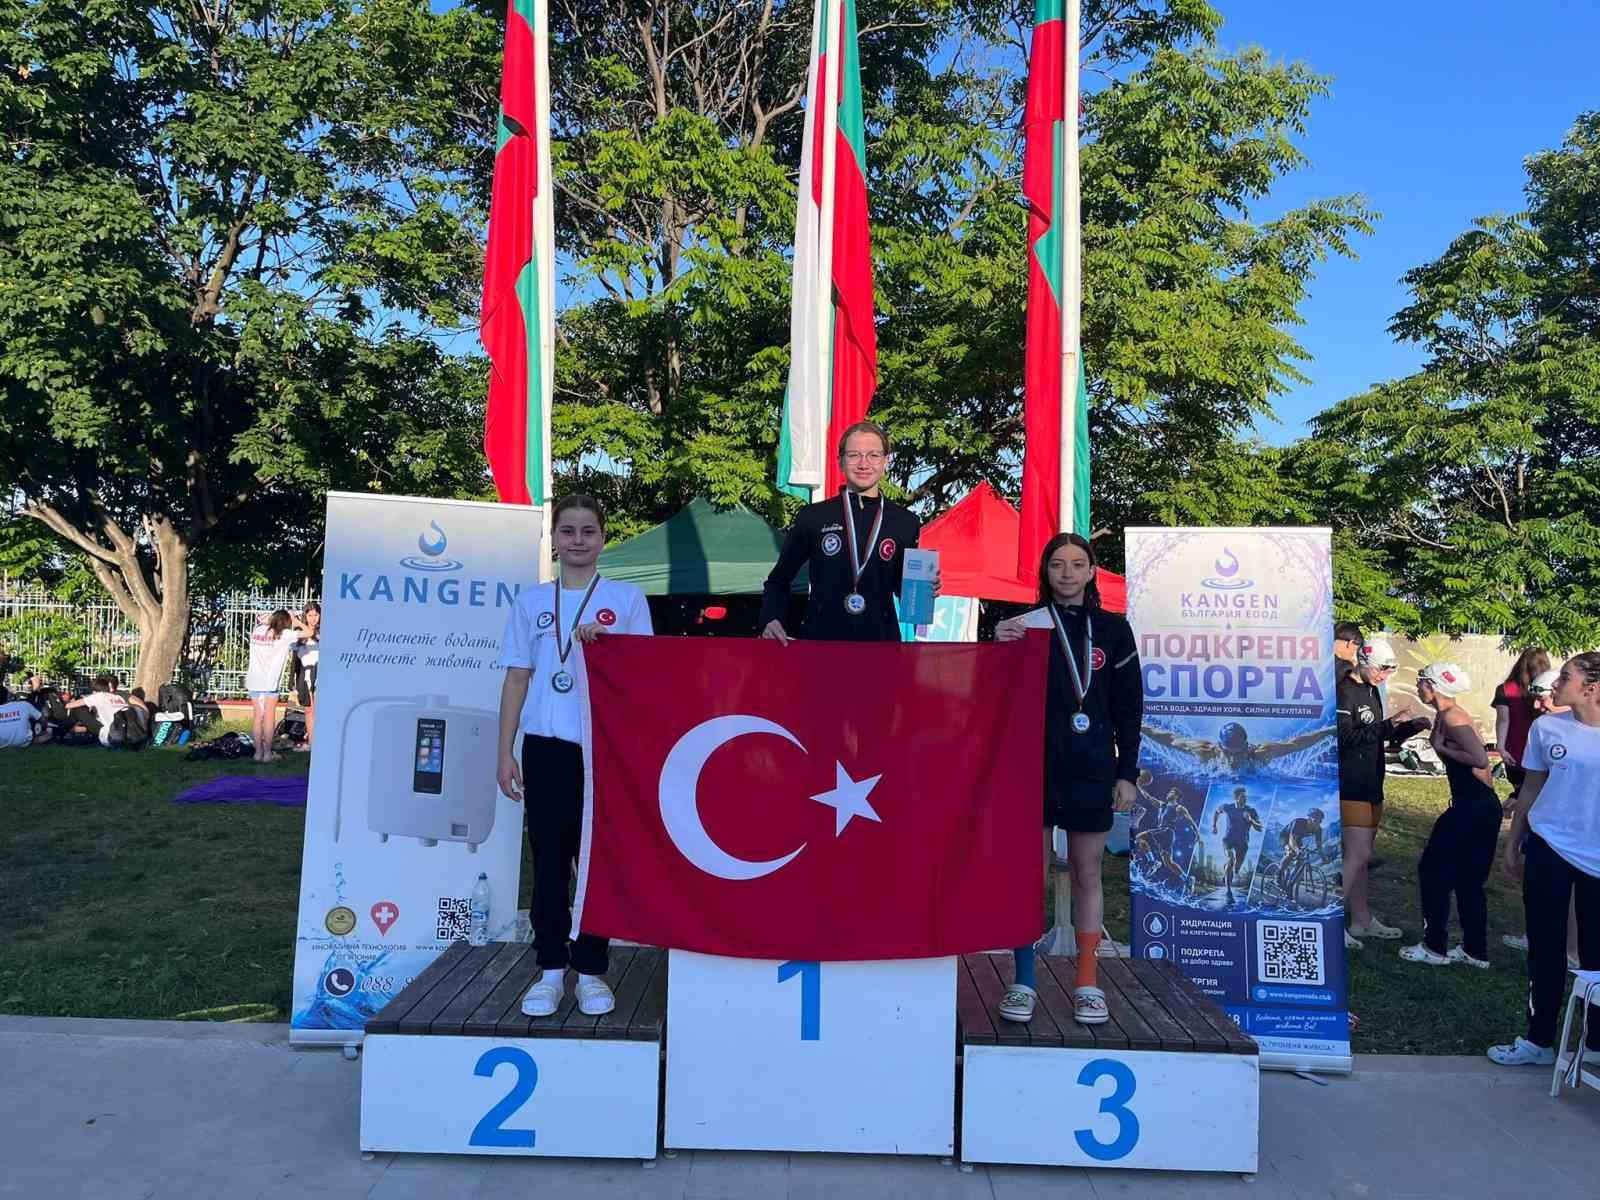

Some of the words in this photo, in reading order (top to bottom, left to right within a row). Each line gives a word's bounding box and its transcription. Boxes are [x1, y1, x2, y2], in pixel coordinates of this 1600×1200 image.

[340, 572, 521, 607] KANGEN
[1181, 592, 1278, 609] KANGEN
[357, 628, 438, 648] Променете
[1141, 633, 1320, 662] ПОДКРЕПЯ
[339, 652, 417, 669] променете
[424, 652, 482, 669] живота
[1142, 663, 1325, 700] СПОРТА
[1180, 919, 1233, 929] ХИДРАТАЦИЯ
[1181, 947, 1225, 957] ПОДКРЕПА
[777, 960, 820, 1040] 1
[469, 1046, 539, 1147] 2
[1074, 1058, 1140, 1161] 3
